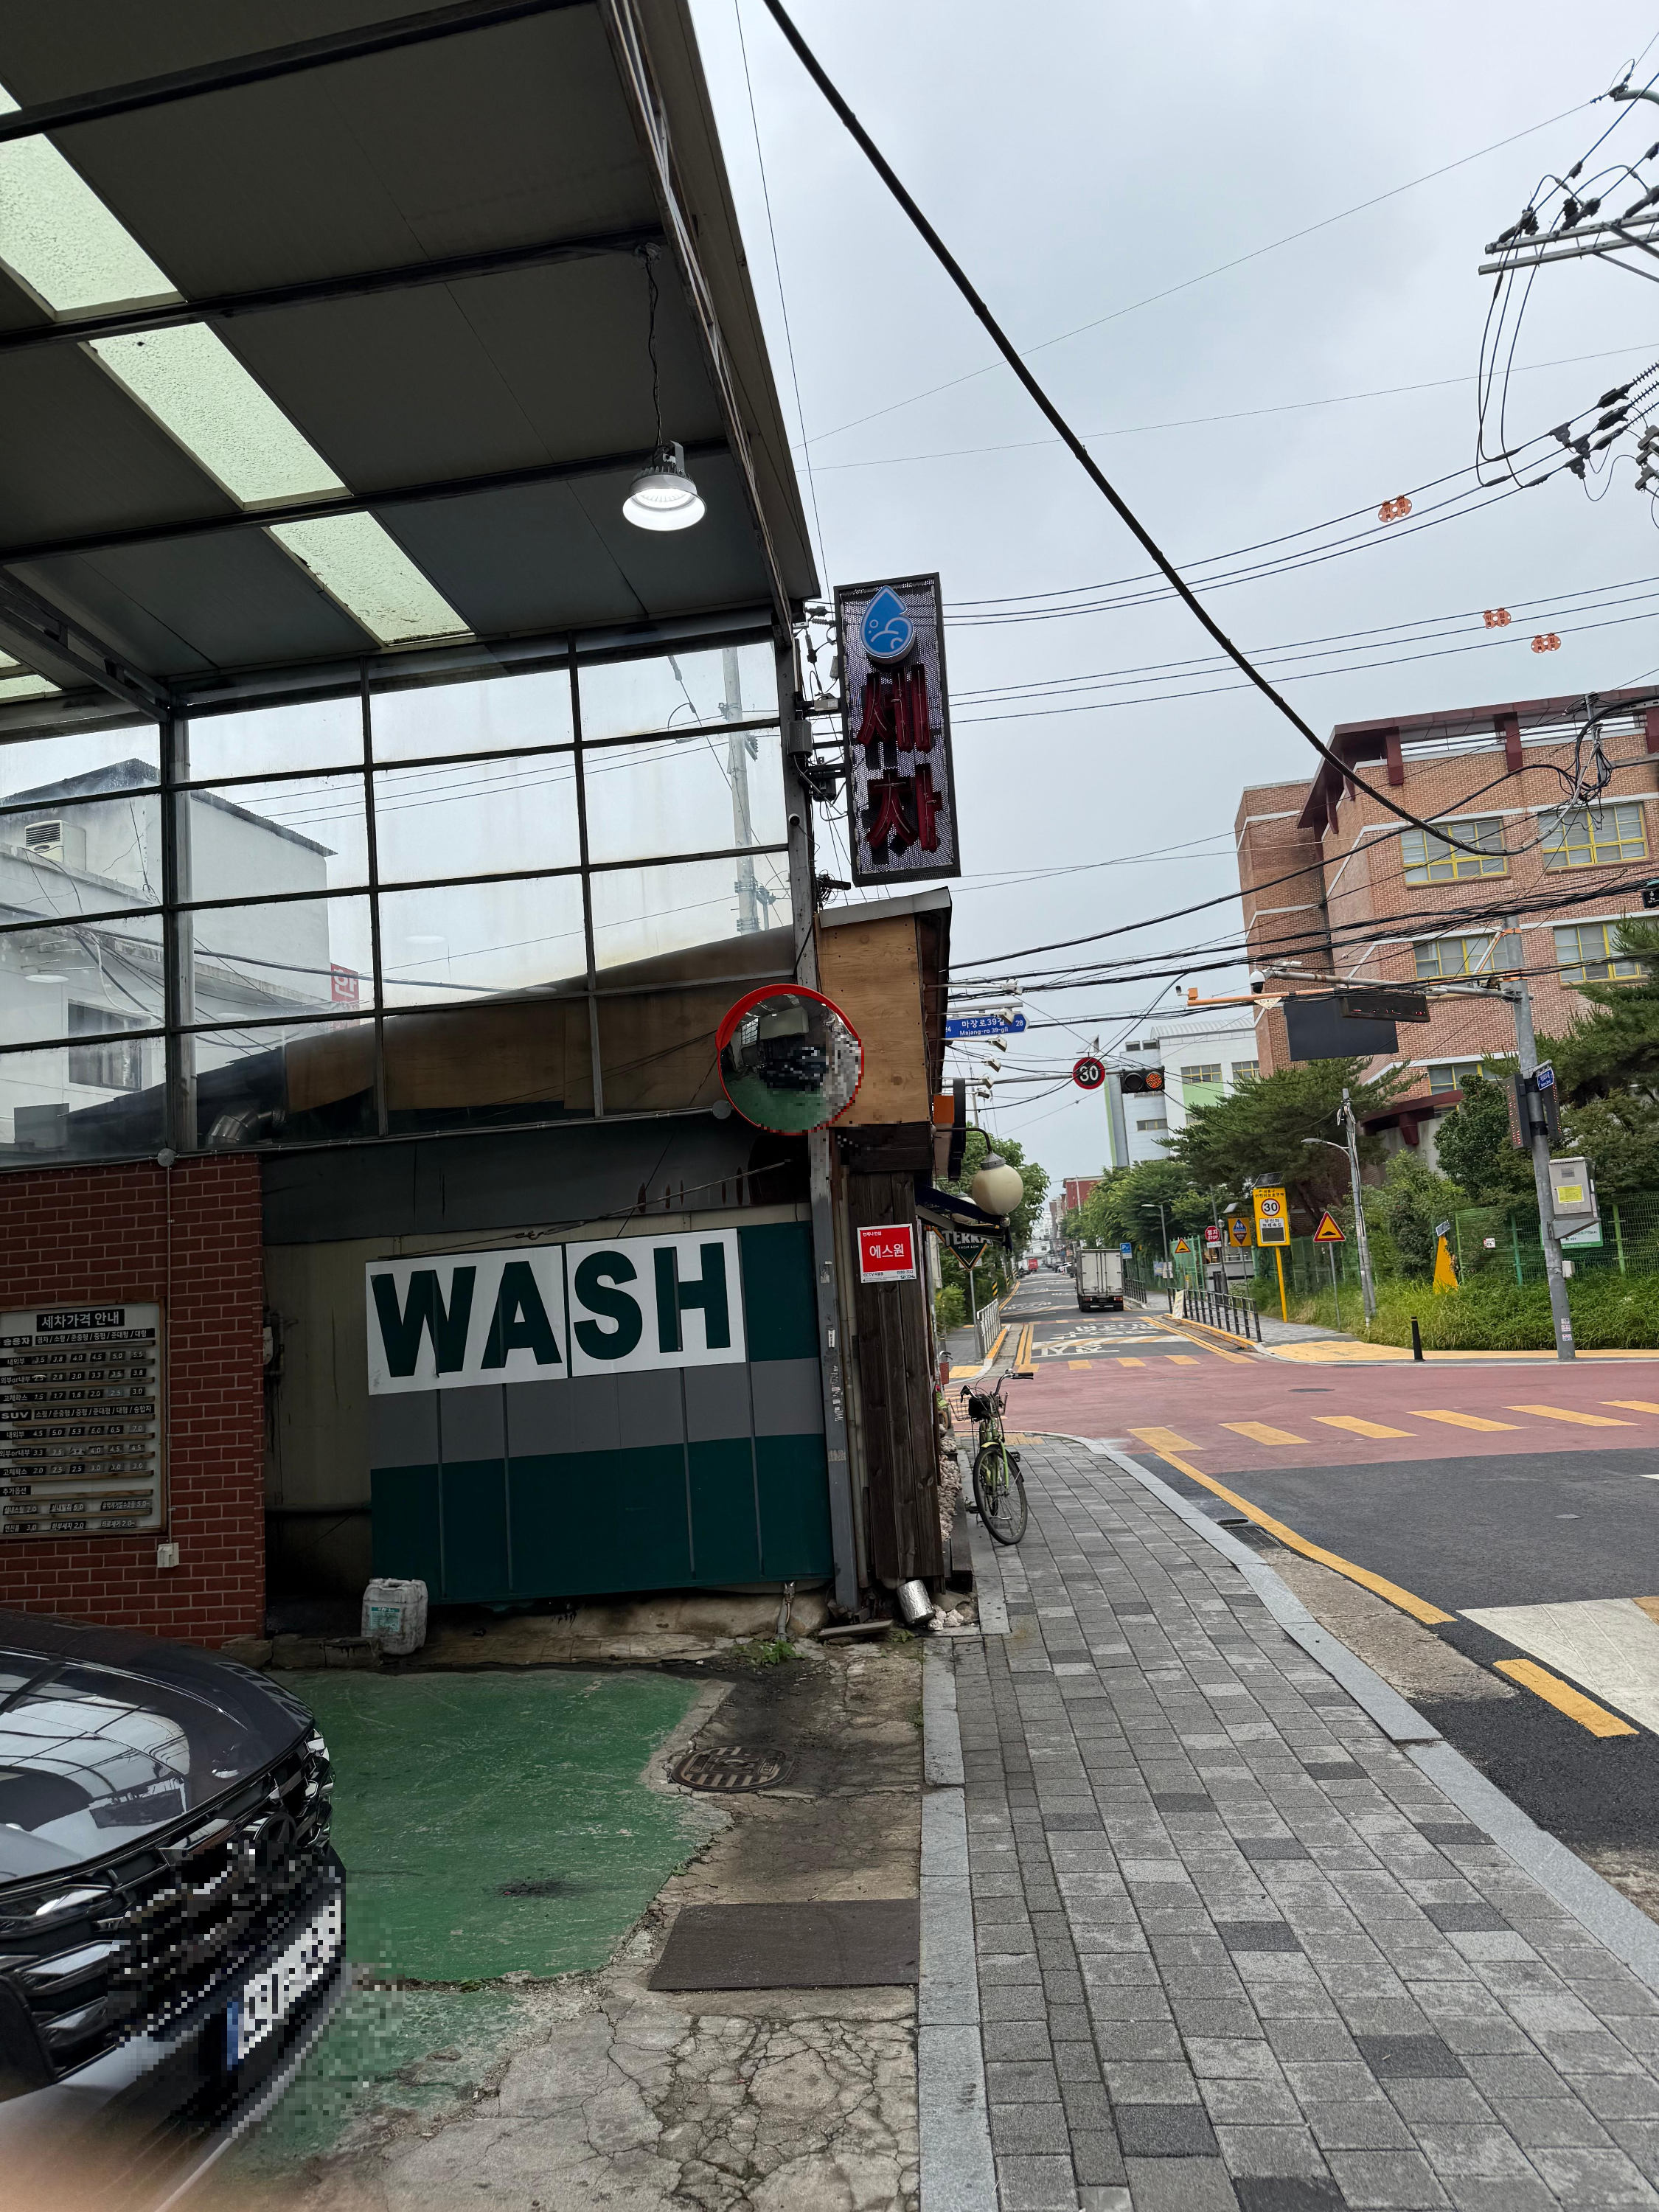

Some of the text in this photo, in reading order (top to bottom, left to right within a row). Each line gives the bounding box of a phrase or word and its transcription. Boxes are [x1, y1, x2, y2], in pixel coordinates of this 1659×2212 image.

[1385, 500, 1405, 513] 위험
[1486, 612, 1505, 621] 위험
[1537, 637, 1555, 645] 위험
[857, 663, 942, 852] 세차
[962, 1018, 1004, 1029] 마장로39길
[1079, 1065, 1099, 1082] 30
[1264, 1203, 1278, 1211] 30
[869, 1243, 904, 1259] 에스원
[370, 1242, 731, 1378] WASH
[42, 1311, 119, 1329] 세차가격 안내
[3, 1337, 30, 1346] 승용차
[38, 1335, 49, 1344] 경차
[54, 1335, 65, 1343] 소형
[111, 1331, 128, 1339] 준대형
[7, 1357, 25, 1366] 내외부
[0, 1375, 30, 1383] 외부or내부
[116, 1406, 128, 1414] 대형
[133, 1405, 152, 1413] 승합차
[7, 1430, 24, 1439] 내외부
[0, 1449, 30, 1458] 외부or내부
[3, 1467, 27, 1475] 고체왁스
[2, 1486, 27, 1495] 추가옵션
